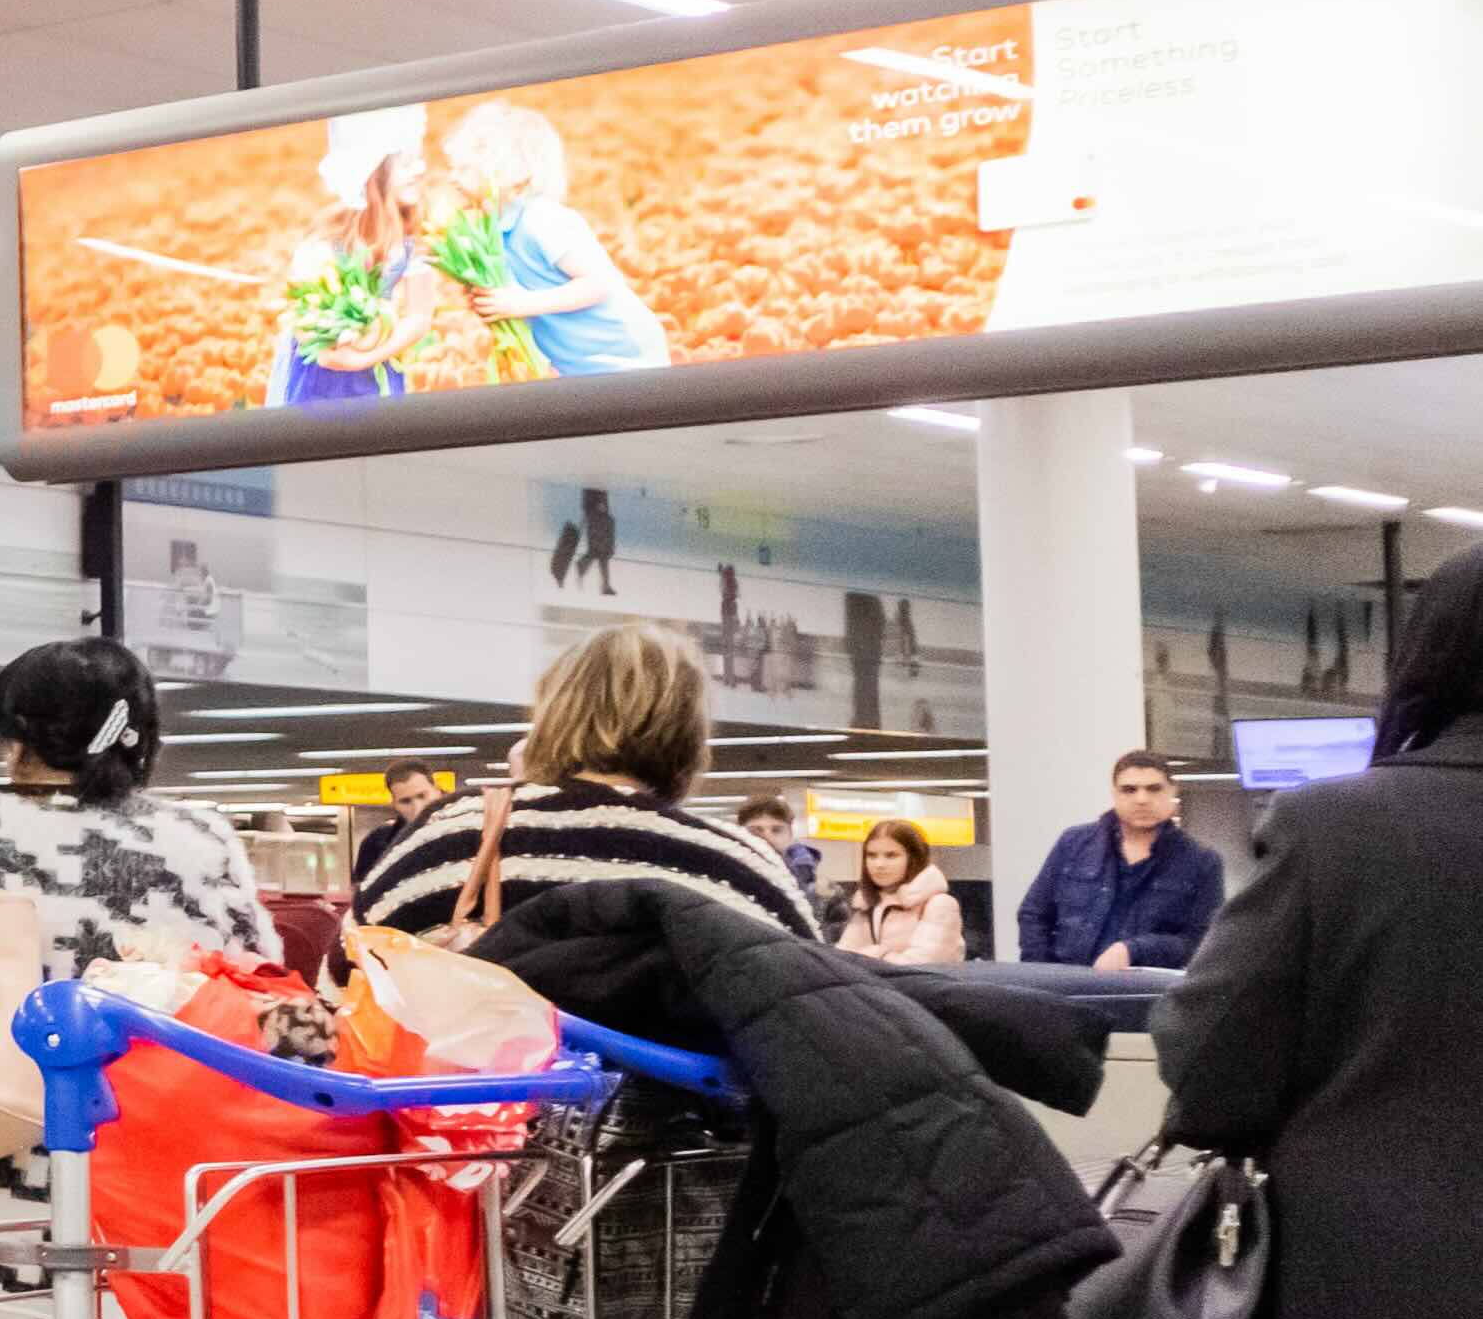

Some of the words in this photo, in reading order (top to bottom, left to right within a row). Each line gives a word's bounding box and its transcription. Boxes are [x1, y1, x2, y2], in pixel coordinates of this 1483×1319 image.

[1055, 18, 1143, 51] Start
[931, 39, 1018, 68] Start
[871, 73, 1020, 110] watchg
[847, 115, 932, 144] them
[940, 102, 1022, 137] grow
[50, 389, 138, 414] mastercard
